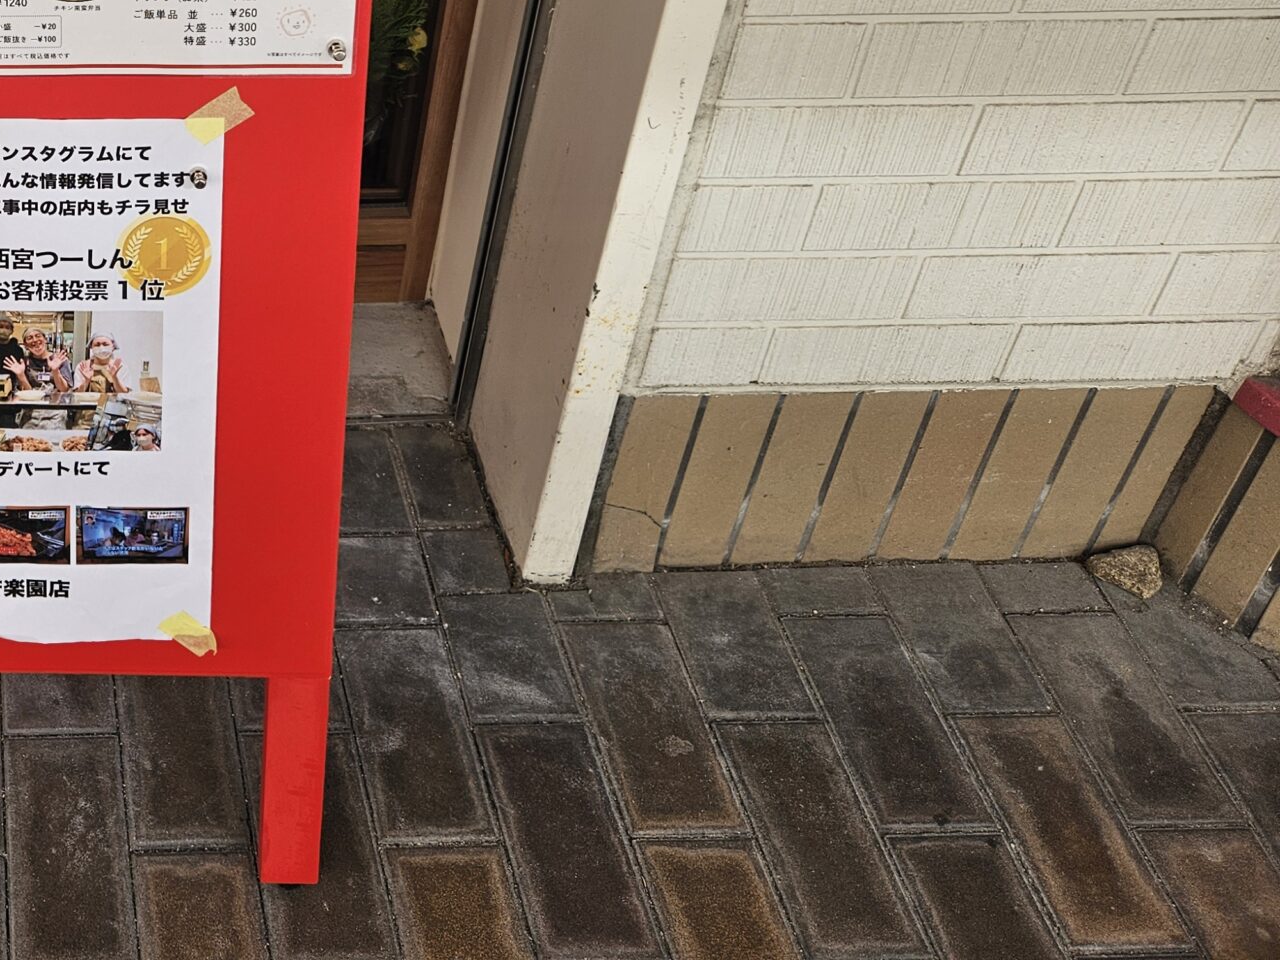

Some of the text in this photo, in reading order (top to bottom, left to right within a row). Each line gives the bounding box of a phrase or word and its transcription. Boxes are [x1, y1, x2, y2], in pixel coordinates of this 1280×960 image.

[229, 8, 258, 18] ¥260
[183, 22, 257, 33] 大盛 ¥300
[183, 36, 257, 47] 特盛 ¥330
